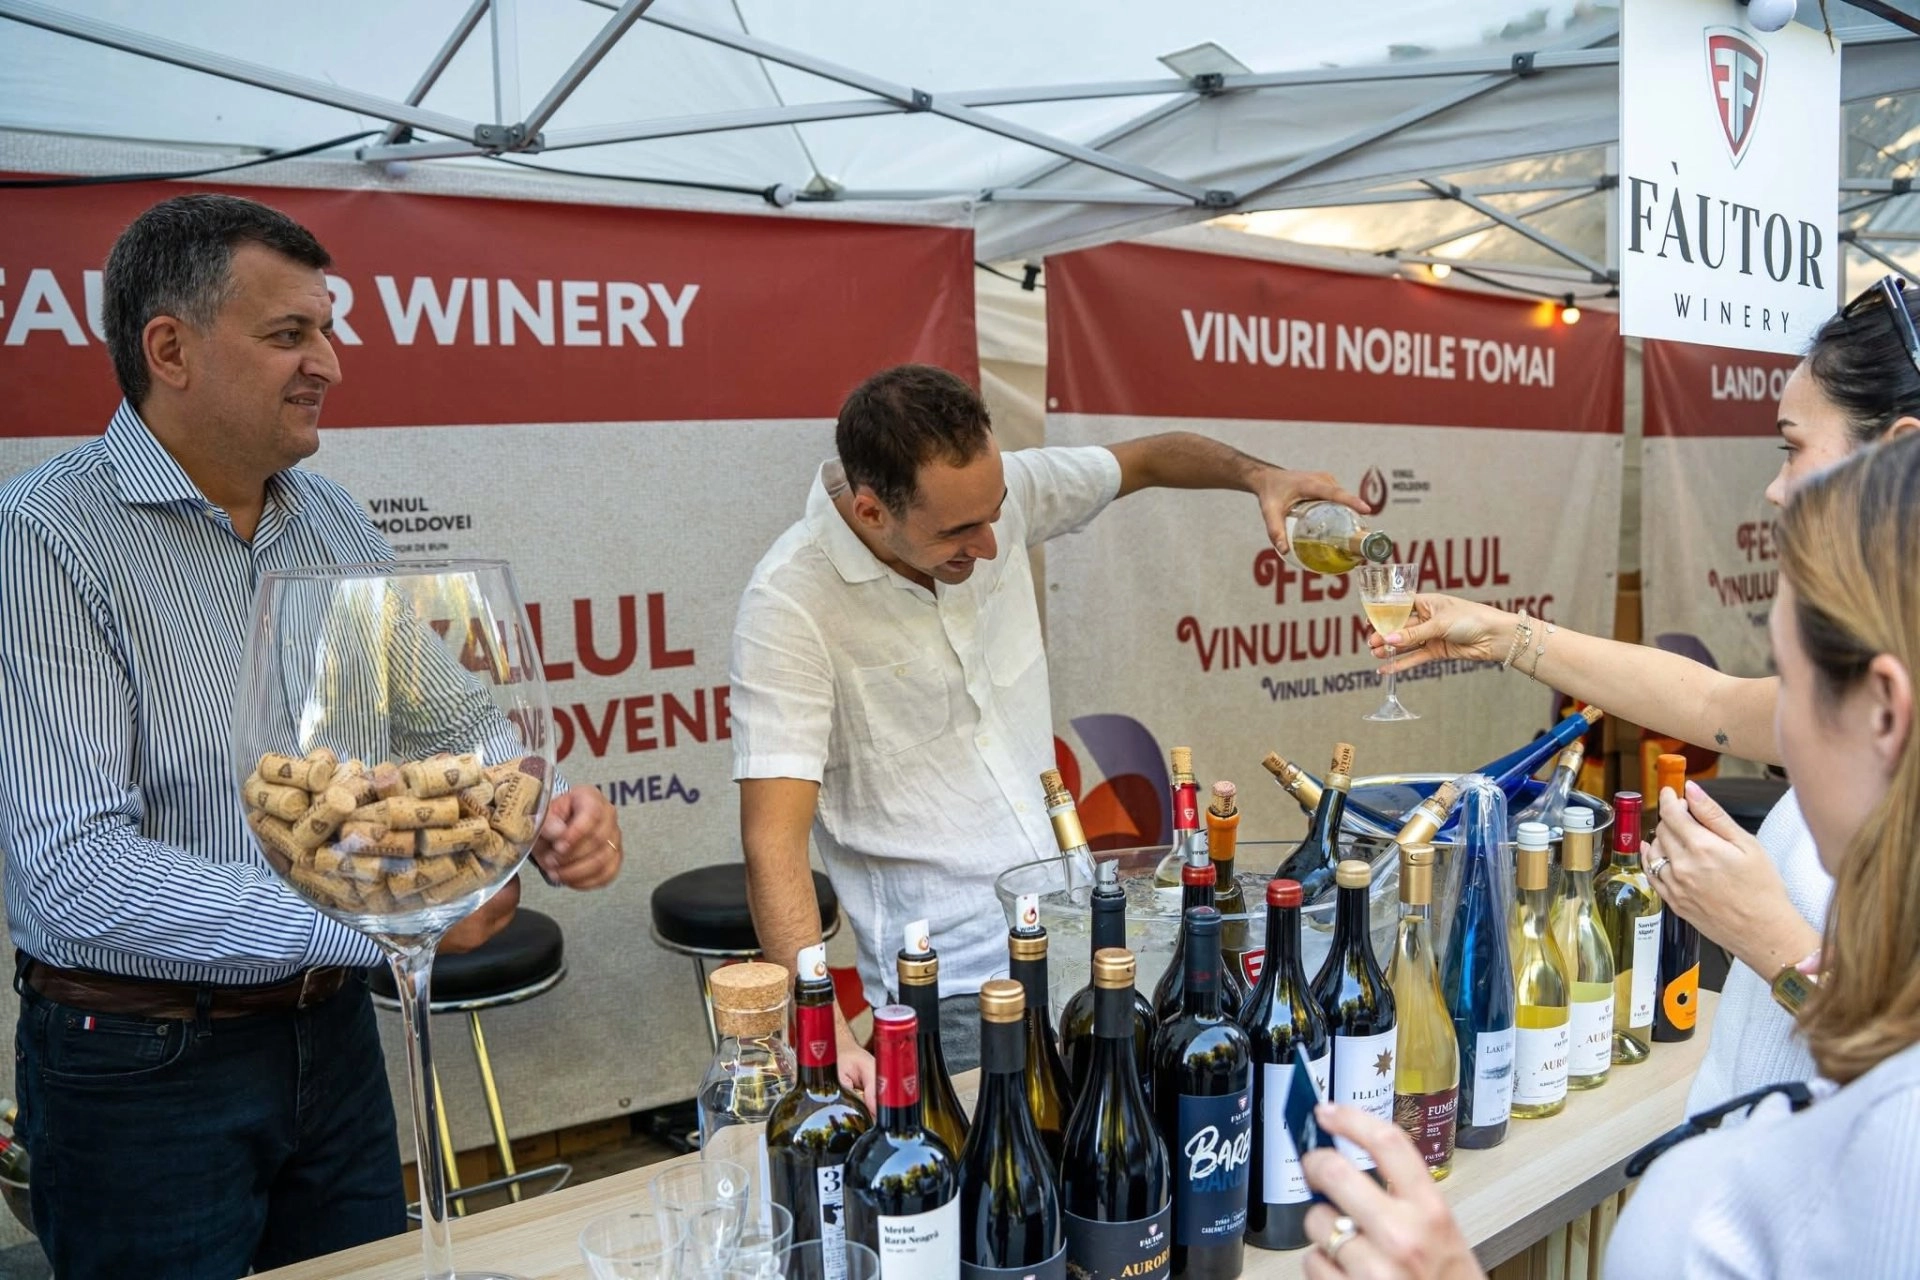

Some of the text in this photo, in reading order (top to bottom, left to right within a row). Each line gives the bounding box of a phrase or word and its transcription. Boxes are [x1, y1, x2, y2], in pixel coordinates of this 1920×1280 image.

[1628, 161, 1824, 289] FÀUTOR
[374, 275, 700, 346] WINERY
[1674, 292, 1789, 333] WINERY
[1182, 308, 1555, 388] VINURI NOBILE TOMAI
[1711, 364, 1767, 400] LAND
[369, 498, 429, 514] VINUL
[371, 514, 471, 534] MOLDOVEI
[1177, 615, 1341, 673] VINULUI
[1261, 677, 1320, 702] VINUL
[1322, 669, 1382, 694] NOSTRU
[1427, 1097, 1453, 1116] FUMÉ
[824, 1170, 841, 1193] 3
[884, 1226, 915, 1234] Merlot
[884, 1236, 906, 1245] Rara
